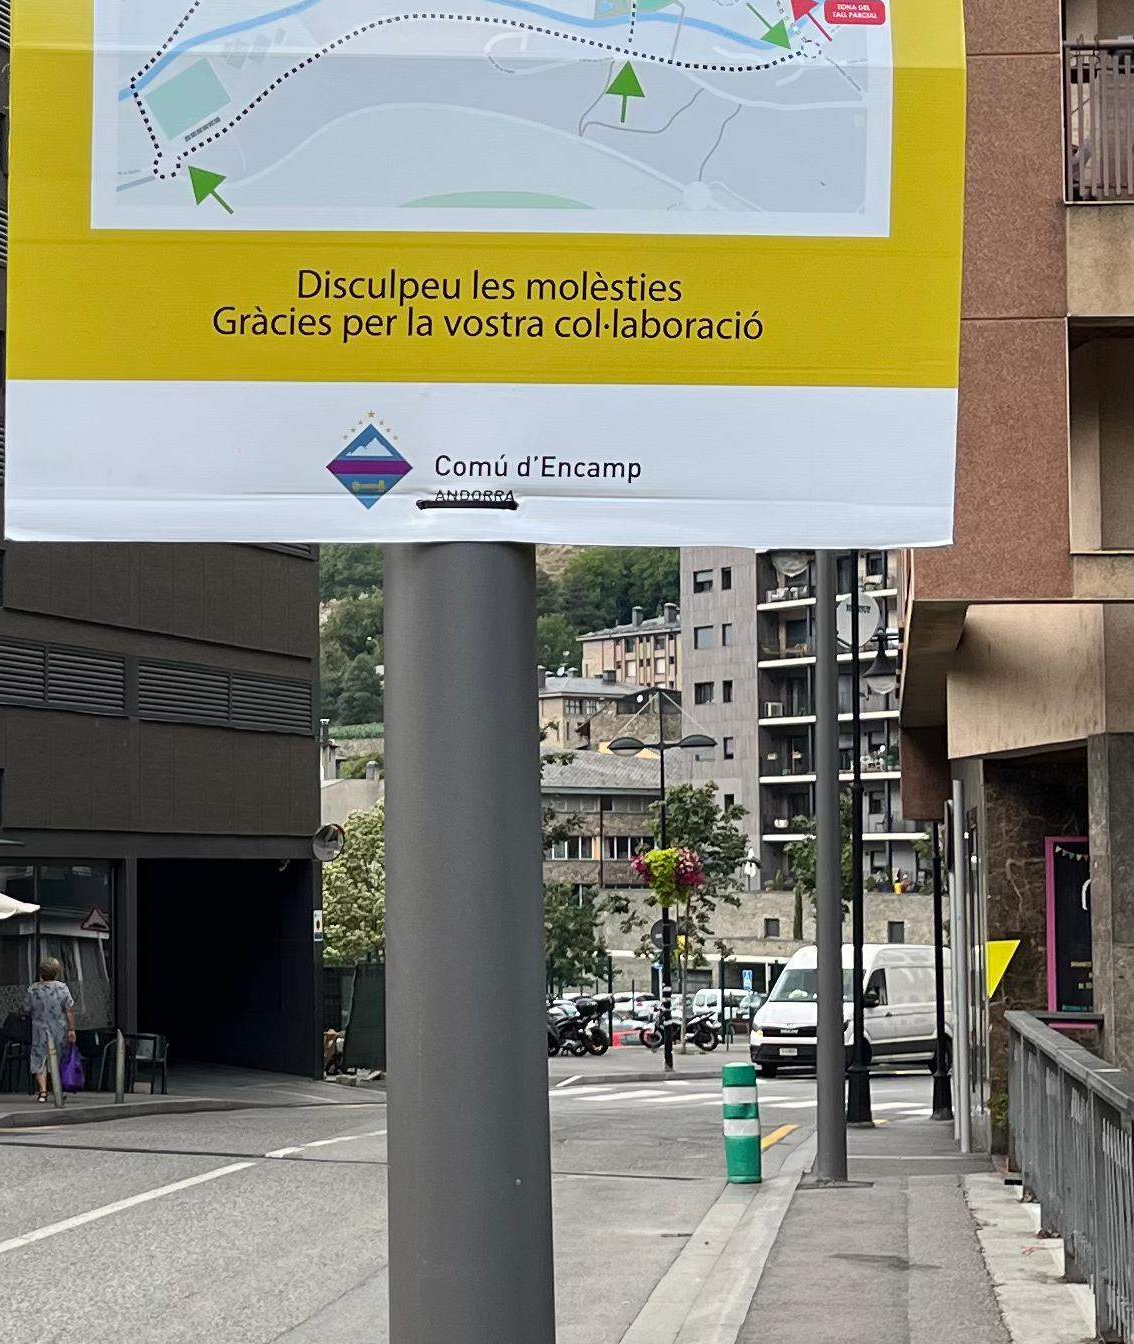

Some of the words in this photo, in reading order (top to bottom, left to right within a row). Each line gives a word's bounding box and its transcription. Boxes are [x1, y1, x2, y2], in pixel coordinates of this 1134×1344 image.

[298, 268, 461, 307] Disculpeu
[472, 269, 515, 300] les
[526, 270, 682, 302] molèsties
[213, 305, 332, 336] Gràcies
[343, 314, 399, 344] per
[407, 306, 433, 337] la
[443, 311, 543, 338] vostra
[554, 307, 763, 340] col·laboració
[435, 453, 508, 477] Comú
[517, 455, 642, 484] d'Encamp
[434, 490, 515, 502] ANDORRA
